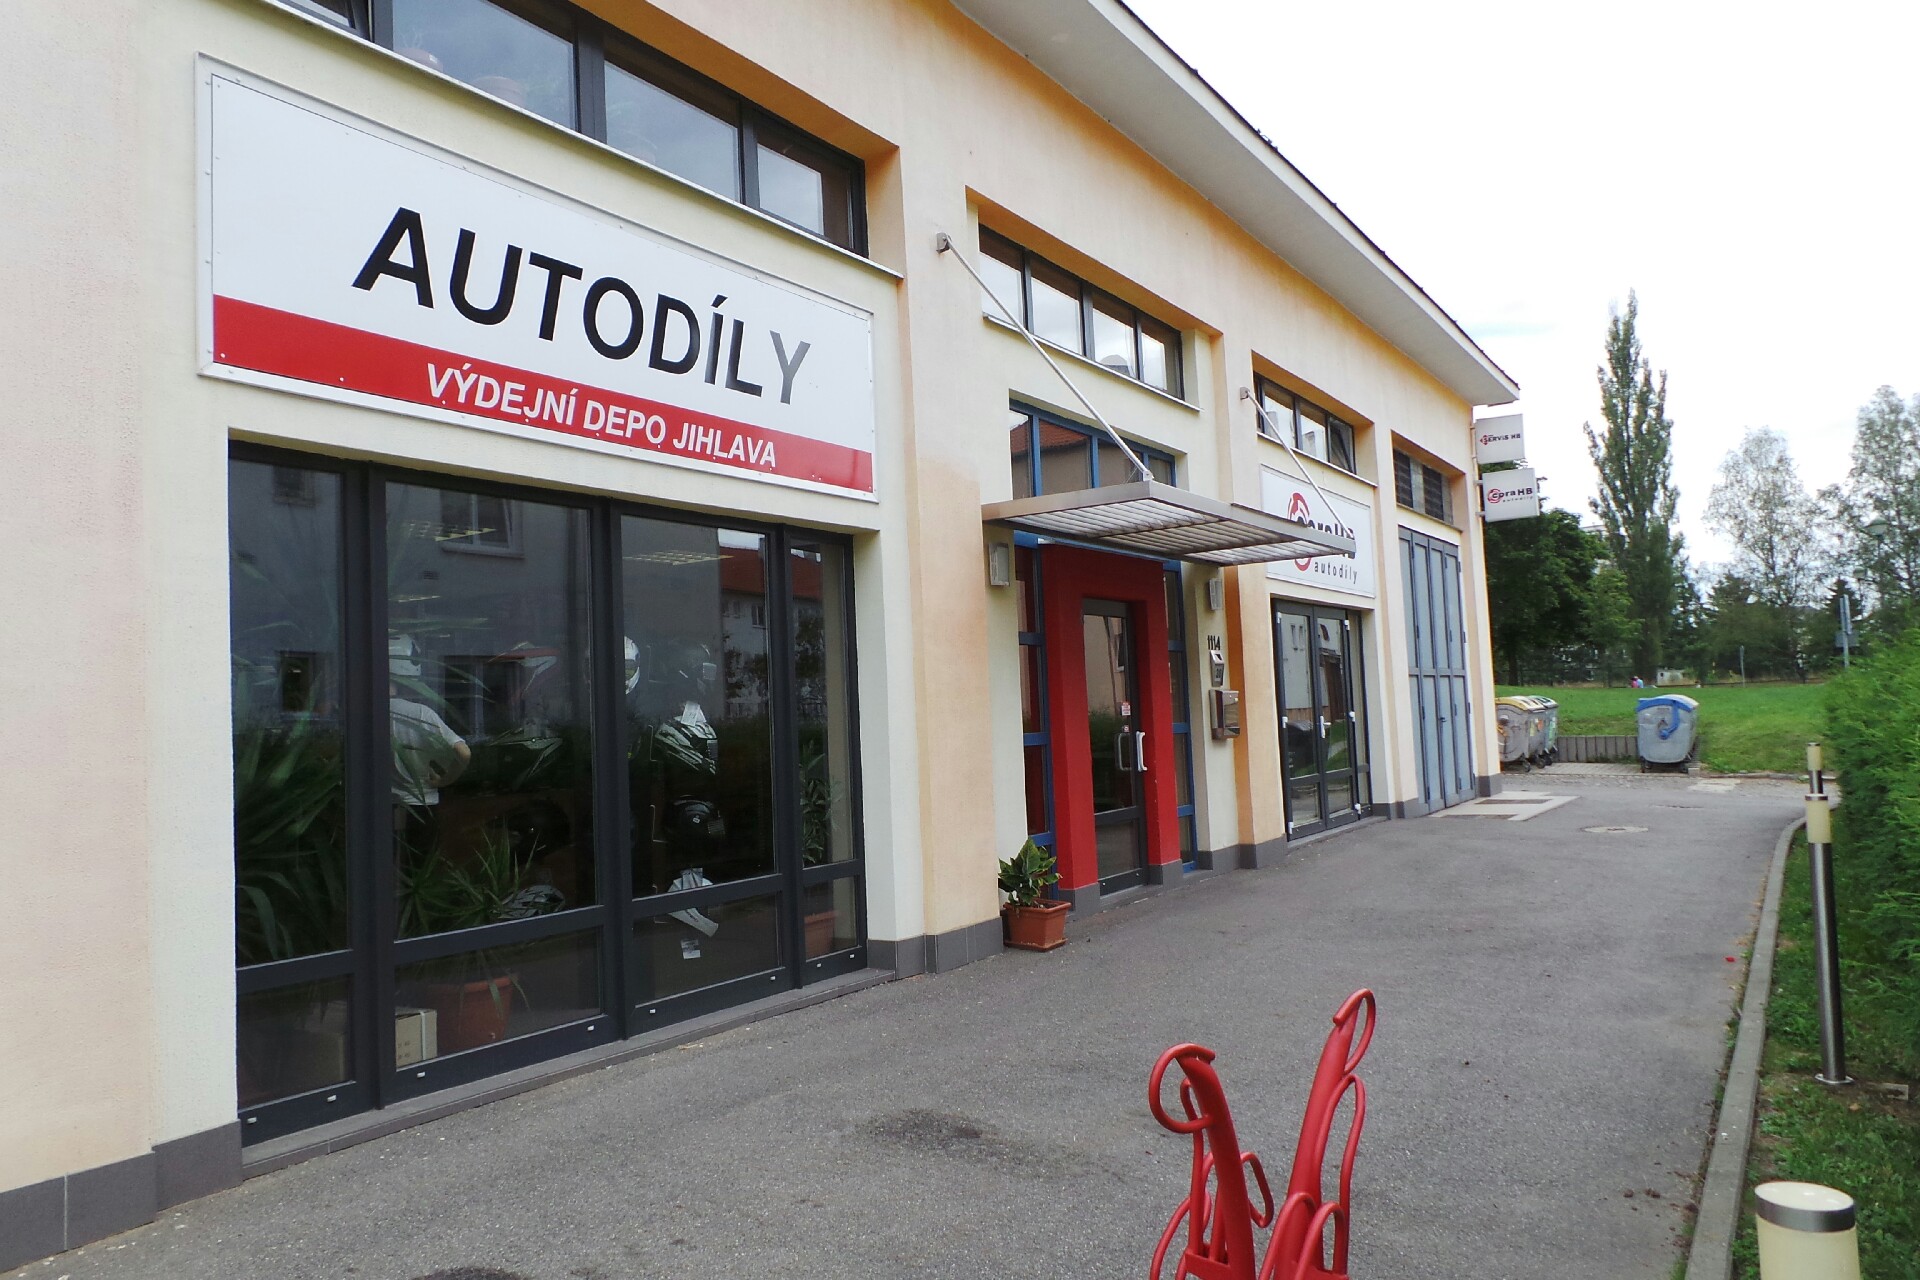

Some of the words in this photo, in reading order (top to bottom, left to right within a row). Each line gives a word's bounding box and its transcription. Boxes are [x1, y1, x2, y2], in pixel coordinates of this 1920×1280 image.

[351, 206, 812, 404] AUTODÍLY
[427, 362, 578, 426] VÝDEJNÍ
[583, 400, 667, 444] DEPO
[672, 422, 776, 468] JIHLAVA
